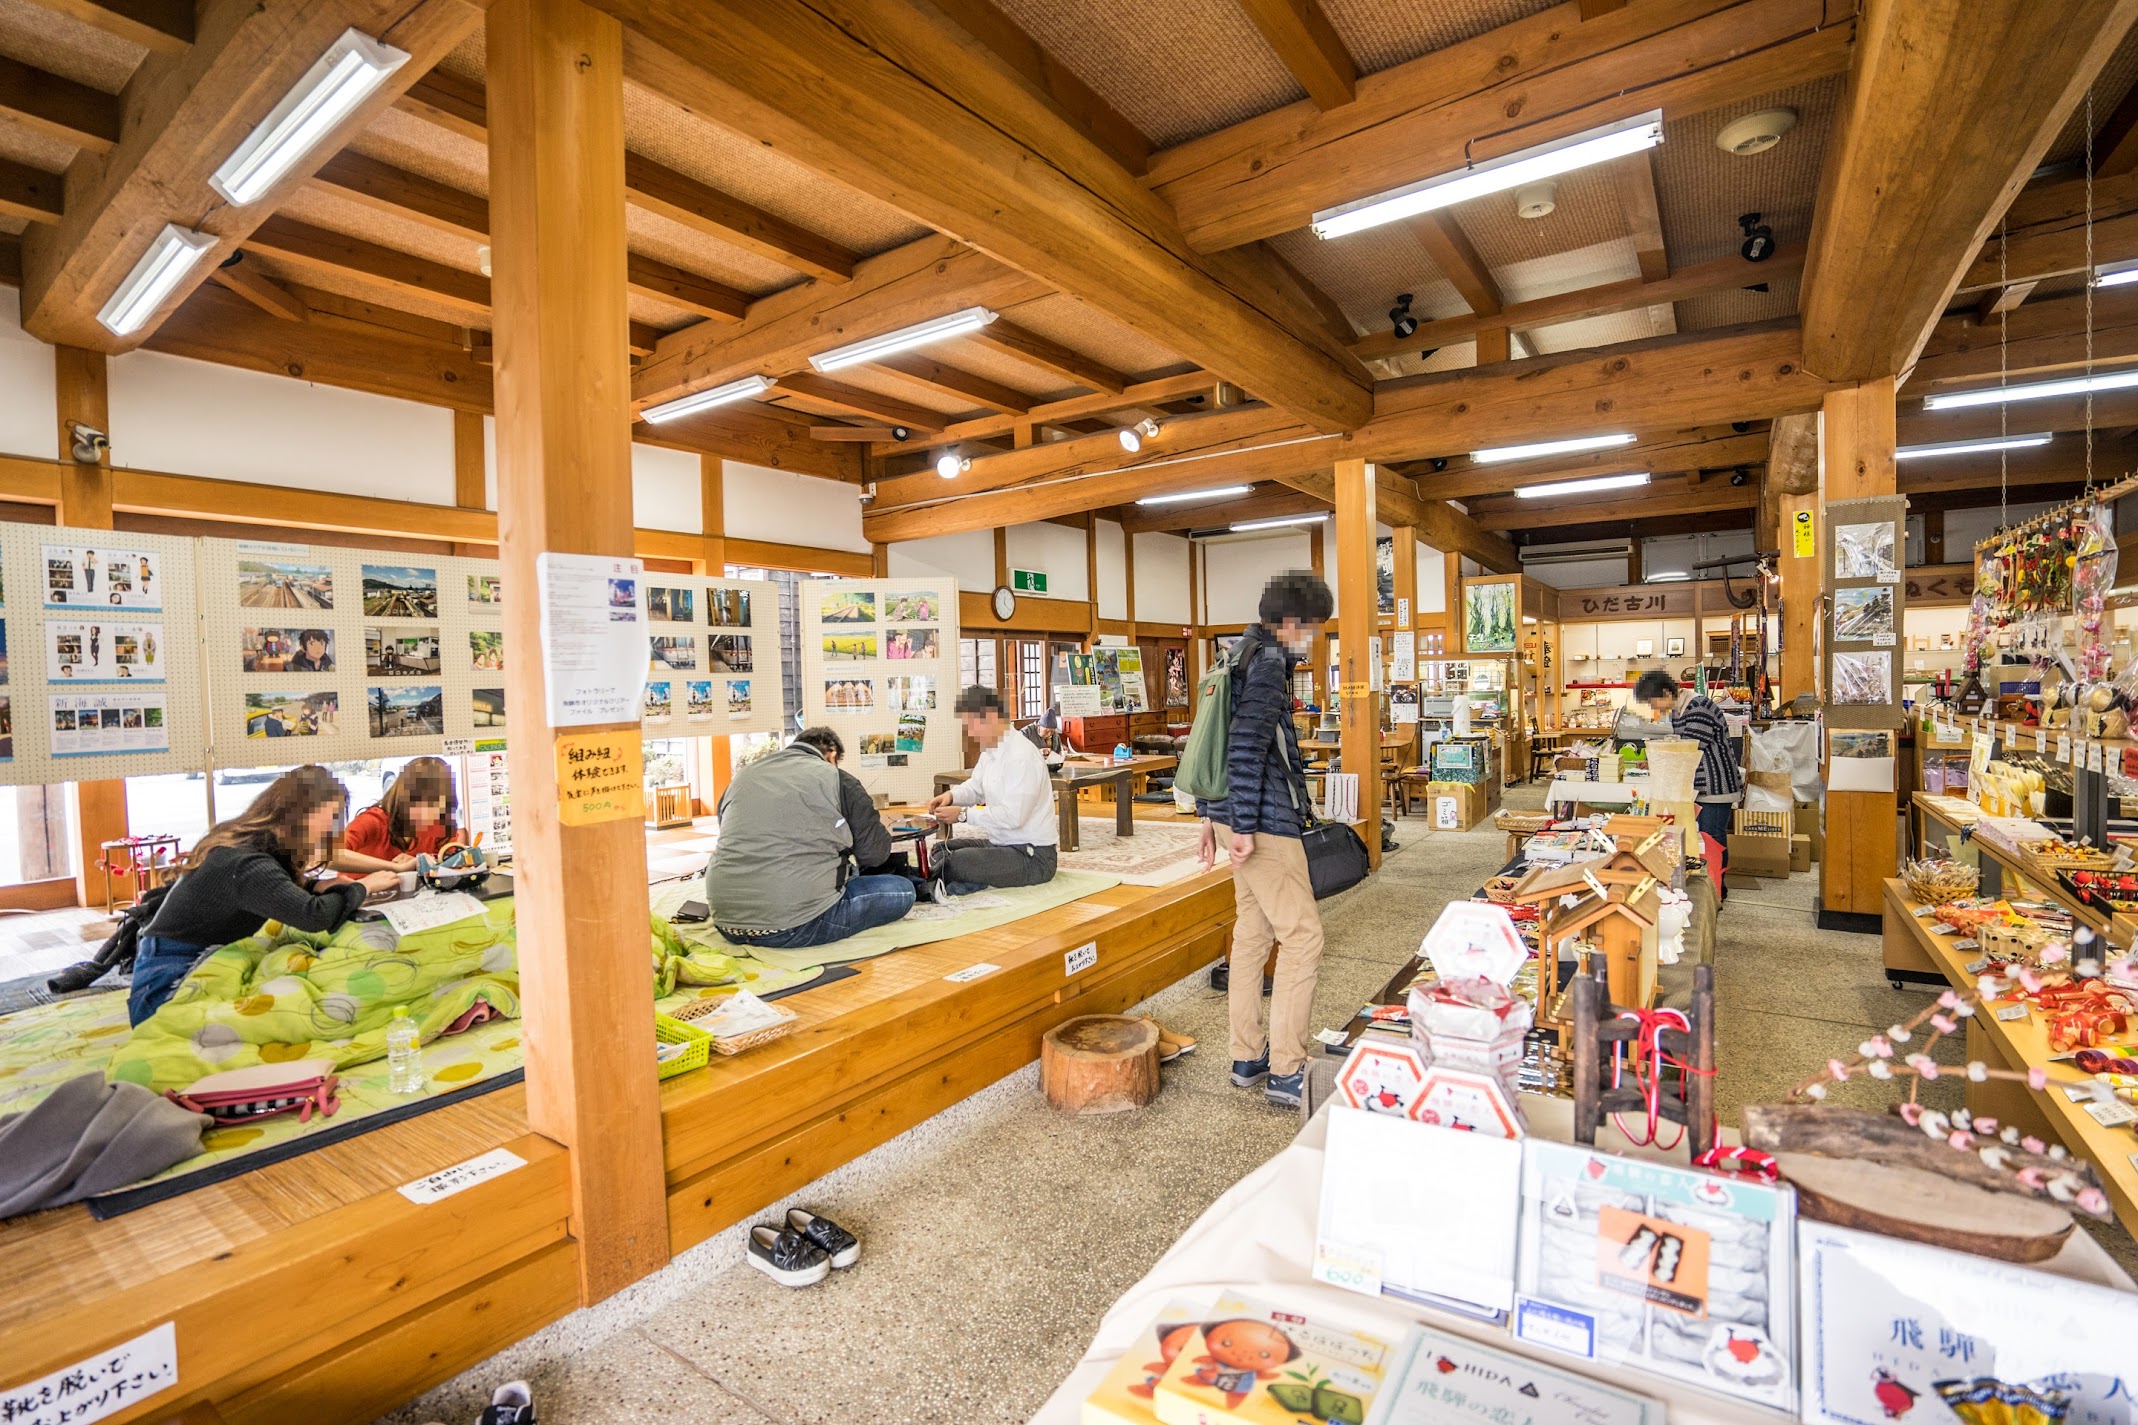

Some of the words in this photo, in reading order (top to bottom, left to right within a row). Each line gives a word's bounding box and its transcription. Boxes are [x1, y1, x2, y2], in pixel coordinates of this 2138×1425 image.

[1581, 594, 1666, 613] ひだ古川
[567, 746, 612, 765] 組み紐
[1463, 1363, 1513, 1388] HIDA
[2, 1352, 131, 1422] 靴を脱いで
